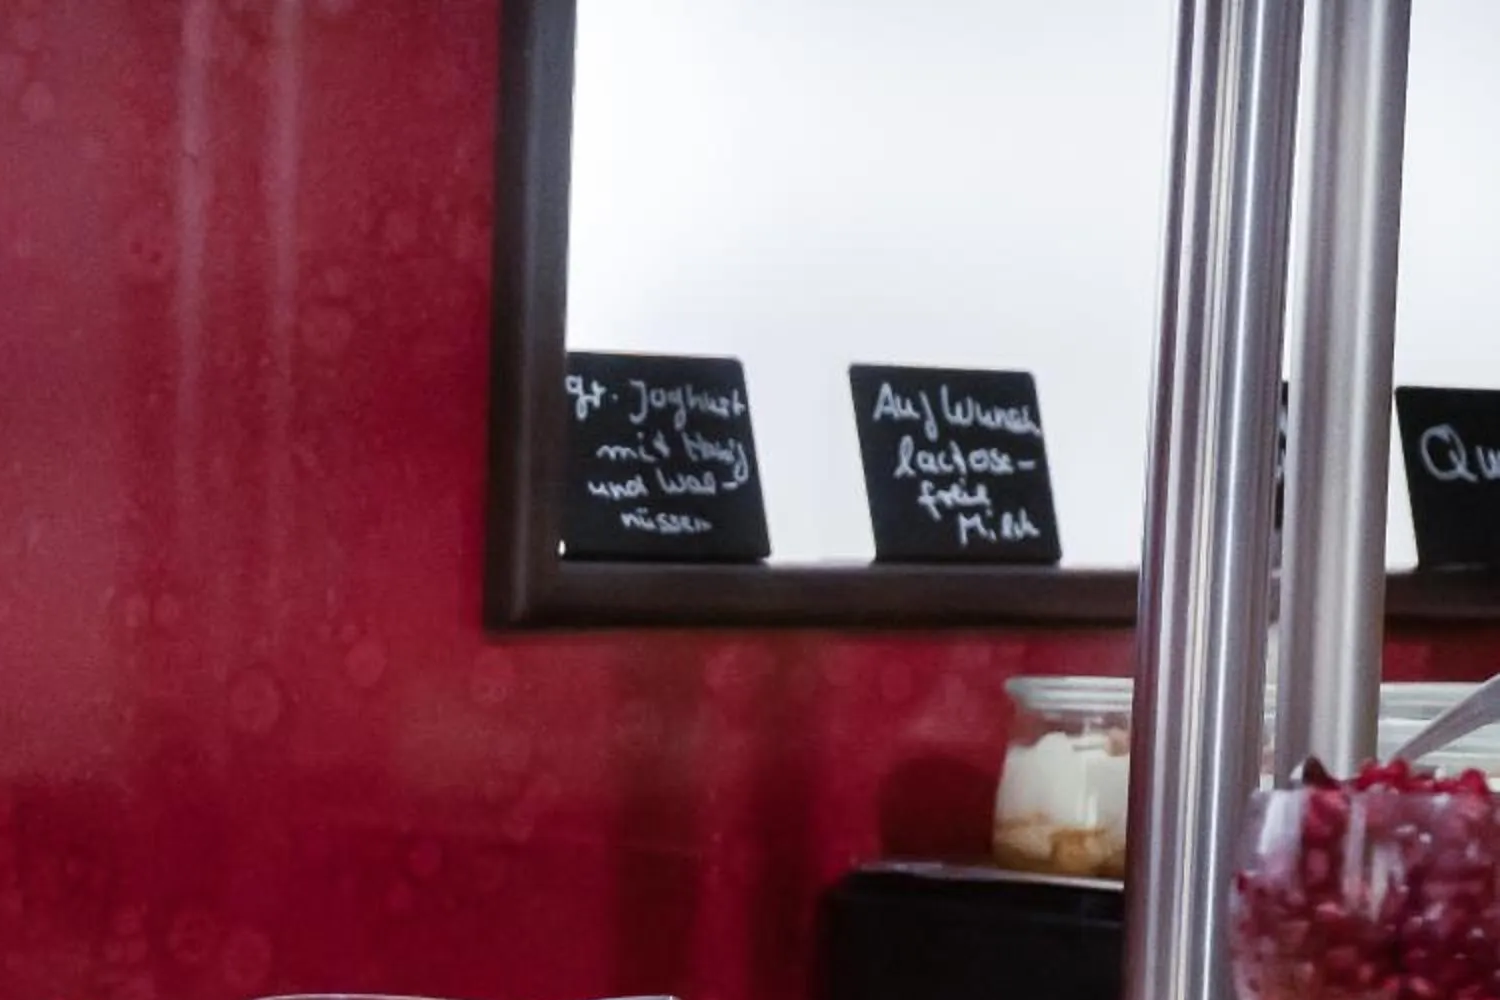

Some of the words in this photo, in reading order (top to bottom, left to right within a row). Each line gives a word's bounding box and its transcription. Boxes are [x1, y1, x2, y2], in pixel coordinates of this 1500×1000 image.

[873, 381, 938, 442] Auf
[596, 429, 670, 462] mit
[1420, 423, 1500, 483] Qu
[588, 474, 649, 500] und
[621, 506, 712, 535] nüssen
